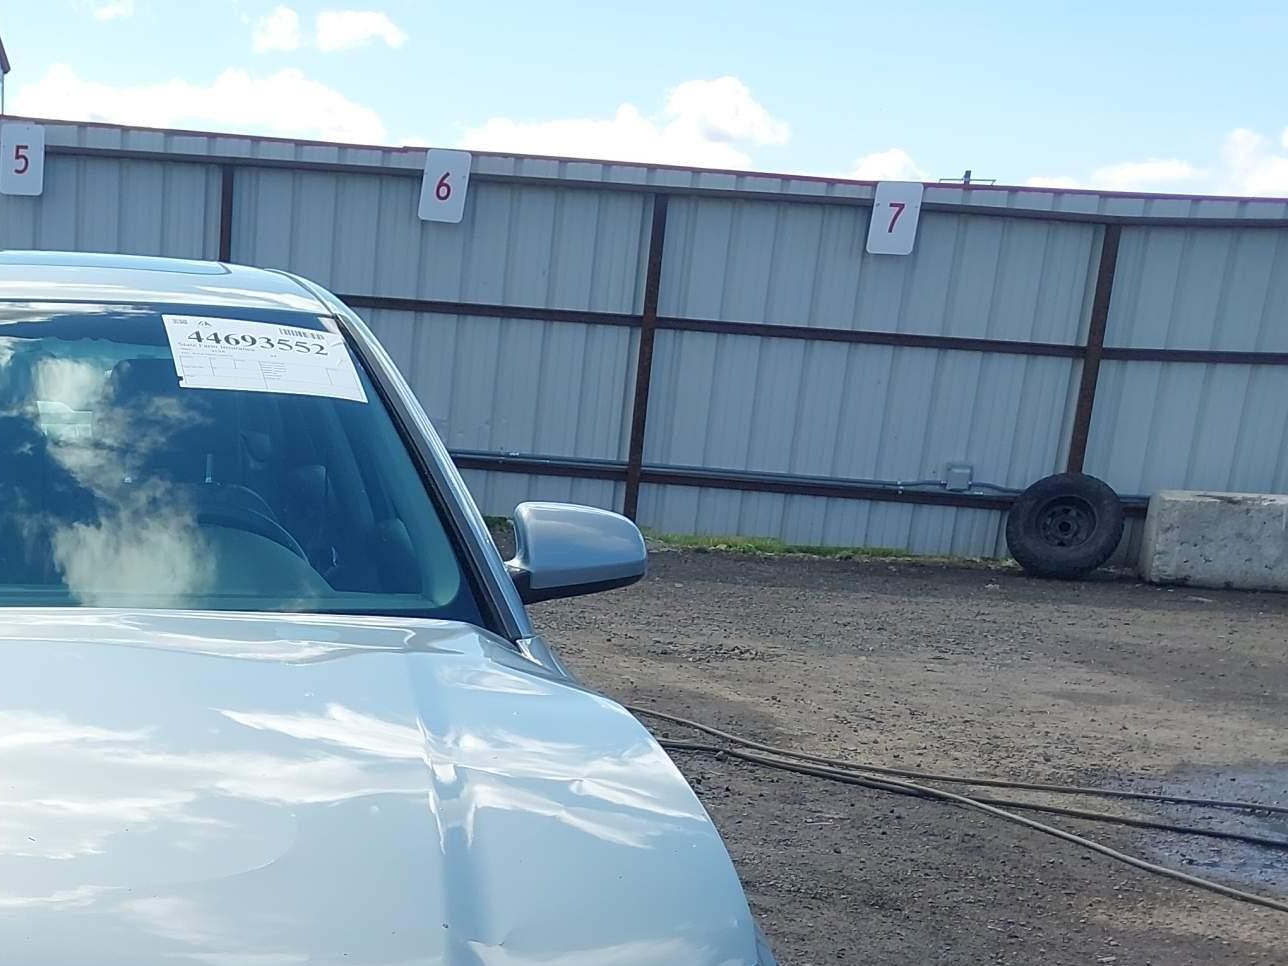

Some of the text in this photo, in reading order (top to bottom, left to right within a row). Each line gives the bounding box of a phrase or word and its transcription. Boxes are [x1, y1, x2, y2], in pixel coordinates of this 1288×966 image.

[14, 145, 29, 175] 5
[436, 172, 452, 201] 6
[888, 203, 905, 233] 7
[187, 330, 329, 356] 44693552
